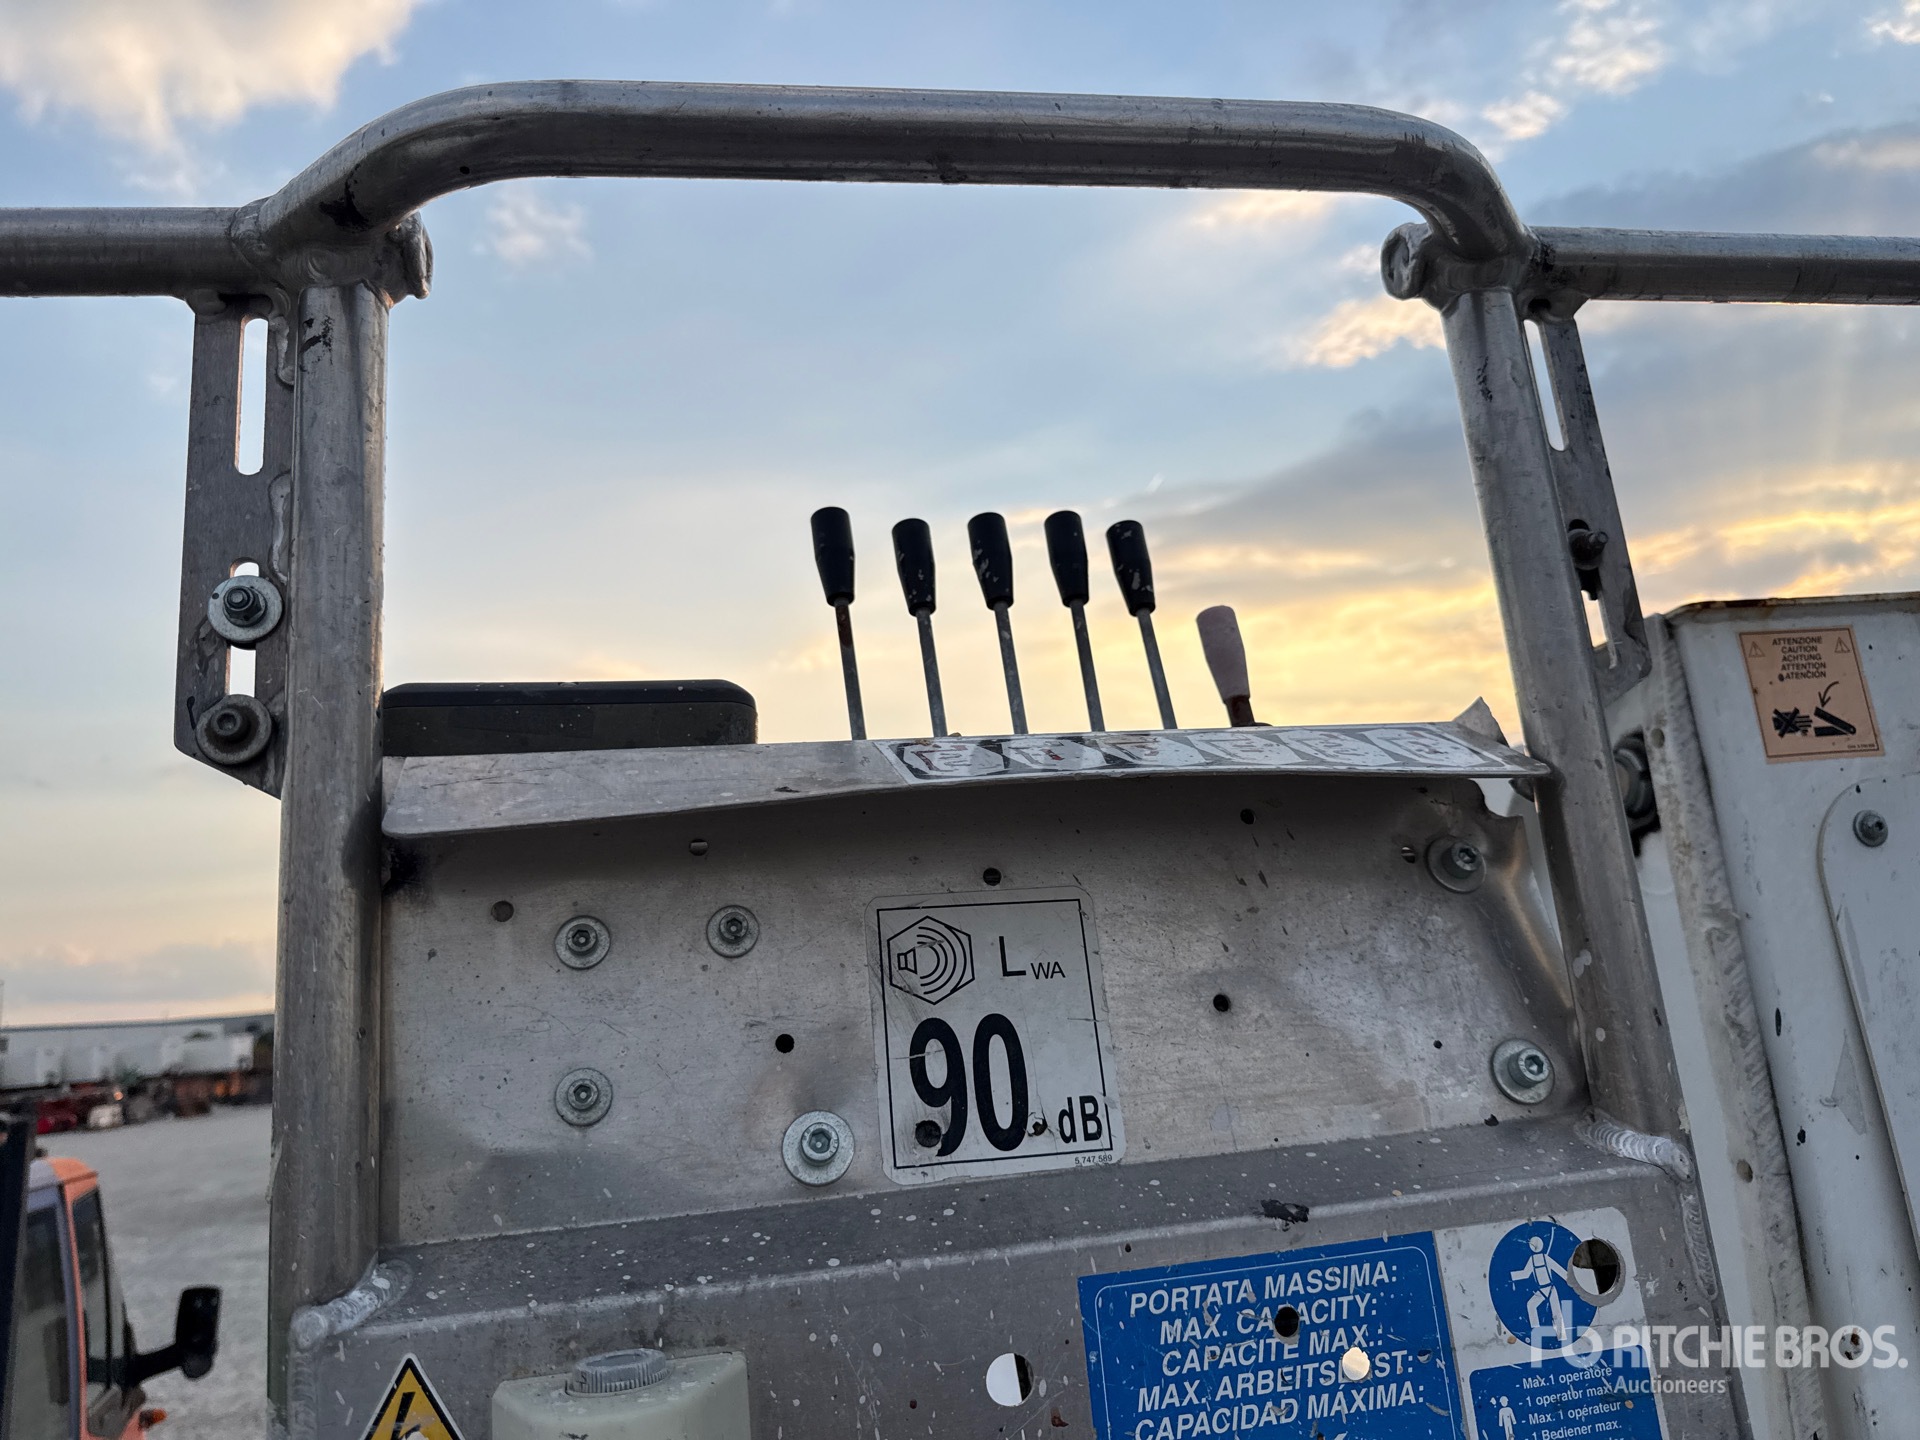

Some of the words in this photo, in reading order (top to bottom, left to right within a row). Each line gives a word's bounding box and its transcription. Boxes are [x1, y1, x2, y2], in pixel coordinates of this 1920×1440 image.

[1772, 636, 1822, 645] ATTENZIONE
[1781, 645, 1818, 654] CAUTION
[1781, 662, 1826, 671] ATTENTION
[1782, 653, 1822, 662] ACHTUNG
[909, 1012, 1029, 1157] 90
[1058, 1095, 1103, 1144] dB
[1129, 1278, 1257, 1318] PORTATA
[1264, 1260, 1397, 1300] MASSIMA:
[1160, 1313, 1228, 1345] MAX.
[1236, 1292, 1377, 1334] CAACITY:
[1138, 1380, 1208, 1413] MAX.
[1215, 1349, 1413, 1402] ARBEITSLST:
[1559, 1366, 1613, 1386] operatore
[1536, 1388, 1583, 1407] operator
[1134, 1398, 1298, 1440] CAPACIDAD
[1307, 1380, 1425, 1420] MÁXIMA:
[1529, 1412, 1556, 1425] Max.
[1541, 1424, 1593, 1440] Bediener
[1595, 1420, 1622, 1433] max.
